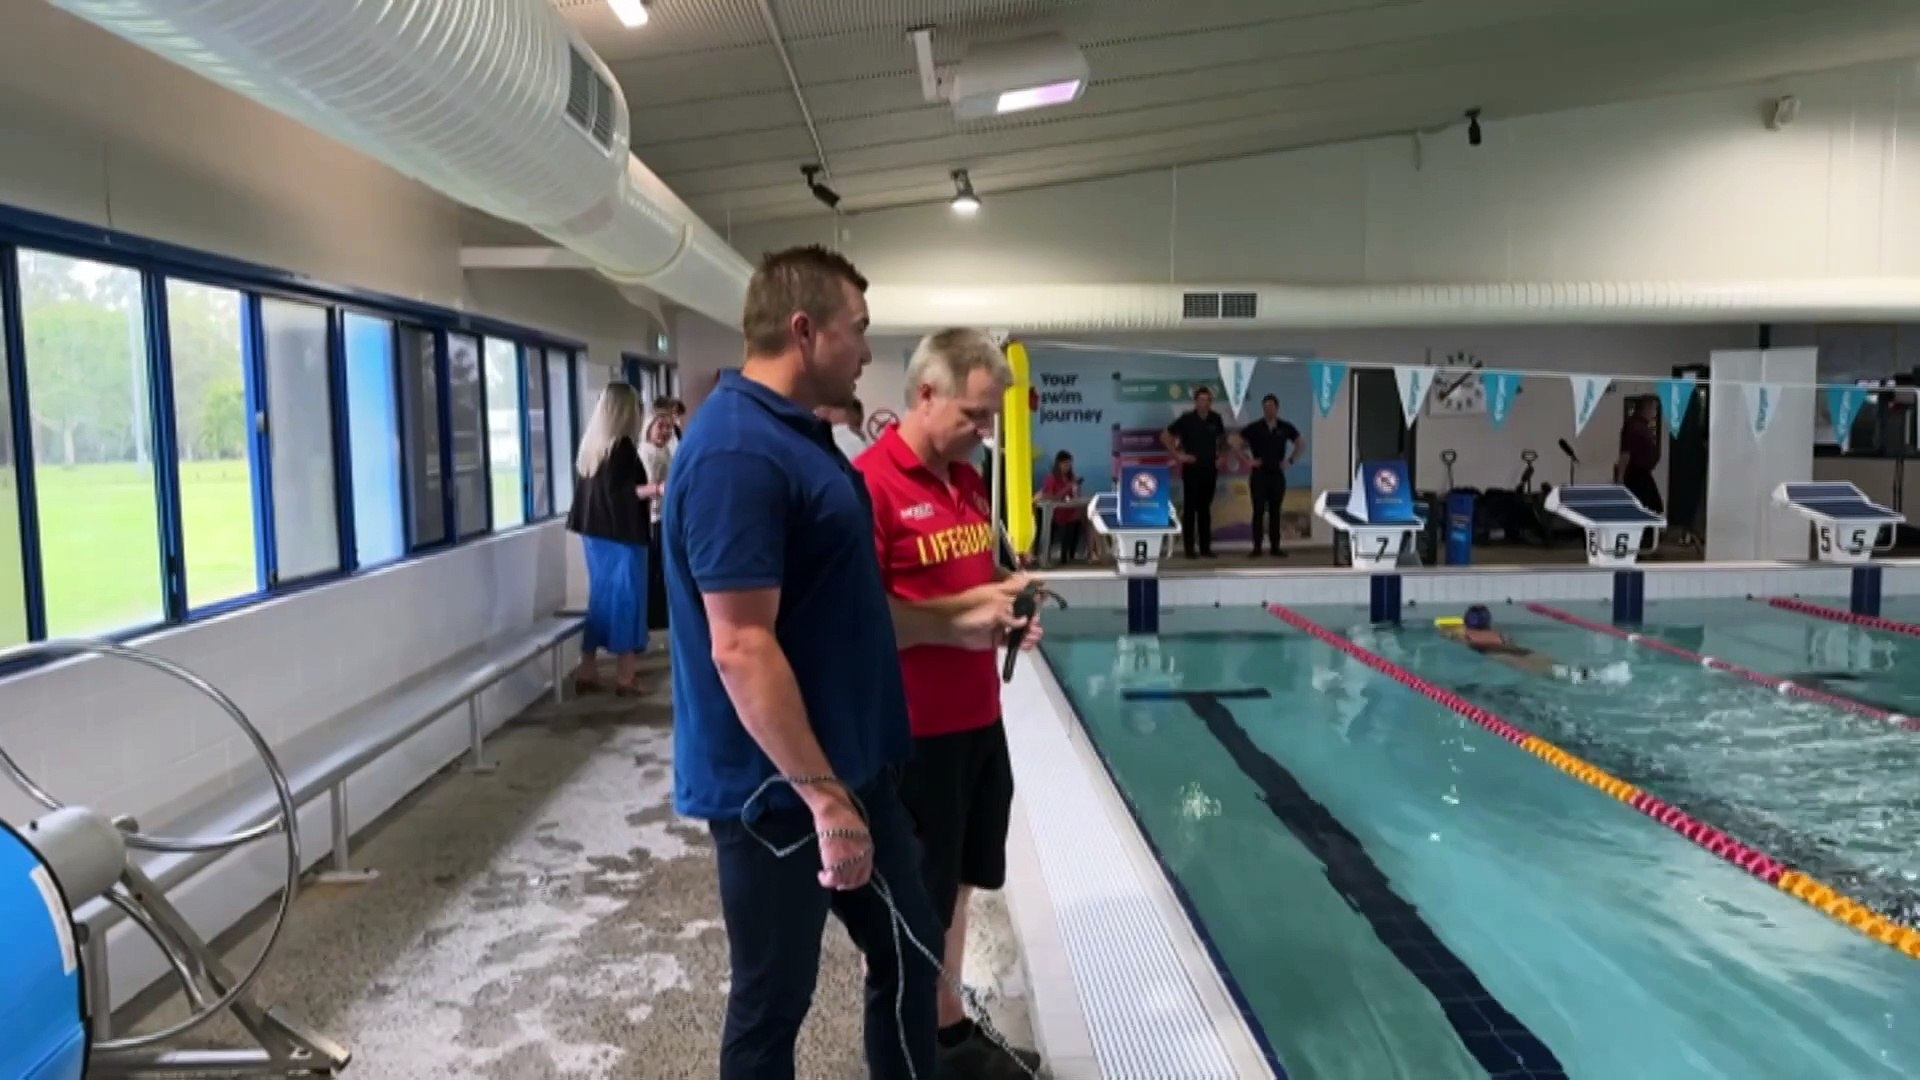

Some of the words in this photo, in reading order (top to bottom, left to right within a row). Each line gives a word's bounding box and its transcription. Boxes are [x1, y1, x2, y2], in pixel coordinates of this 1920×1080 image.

[1040, 372, 1079, 387] Your
[1040, 389, 1082, 404] swim
[1039, 406, 1103, 425] journey
[916, 522, 993, 566] LIFEGUA
[1134, 540, 1147, 565] 8
[1375, 536, 1389, 562] 7
[1614, 533, 1630, 559] 6
[1820, 526, 1831, 553] 5
[1849, 529, 1867, 555] 5
